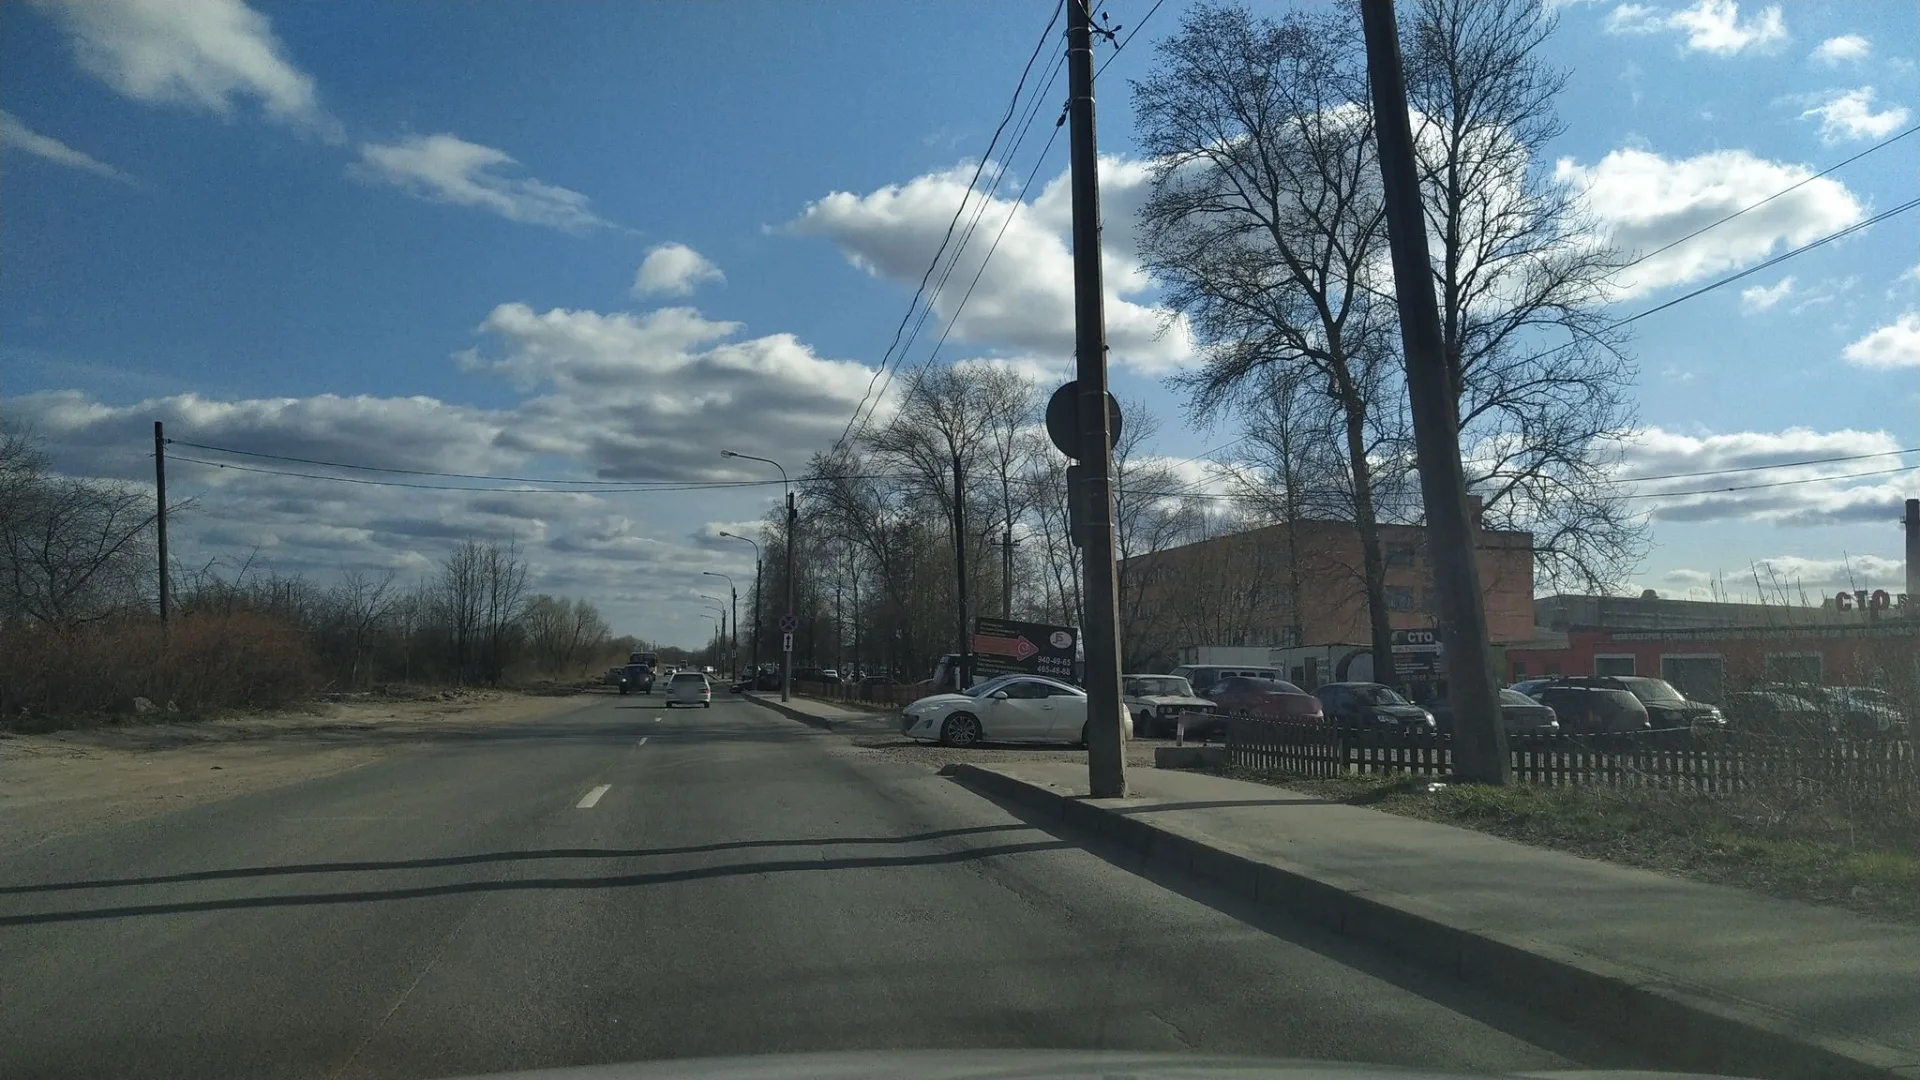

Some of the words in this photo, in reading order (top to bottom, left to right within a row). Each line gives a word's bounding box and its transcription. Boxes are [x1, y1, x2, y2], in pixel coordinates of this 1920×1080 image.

[1836, 589, 1890, 612] СТО
[1408, 631, 1433, 643] СТО
[1037, 655, 1072, 666] 940-49-65
